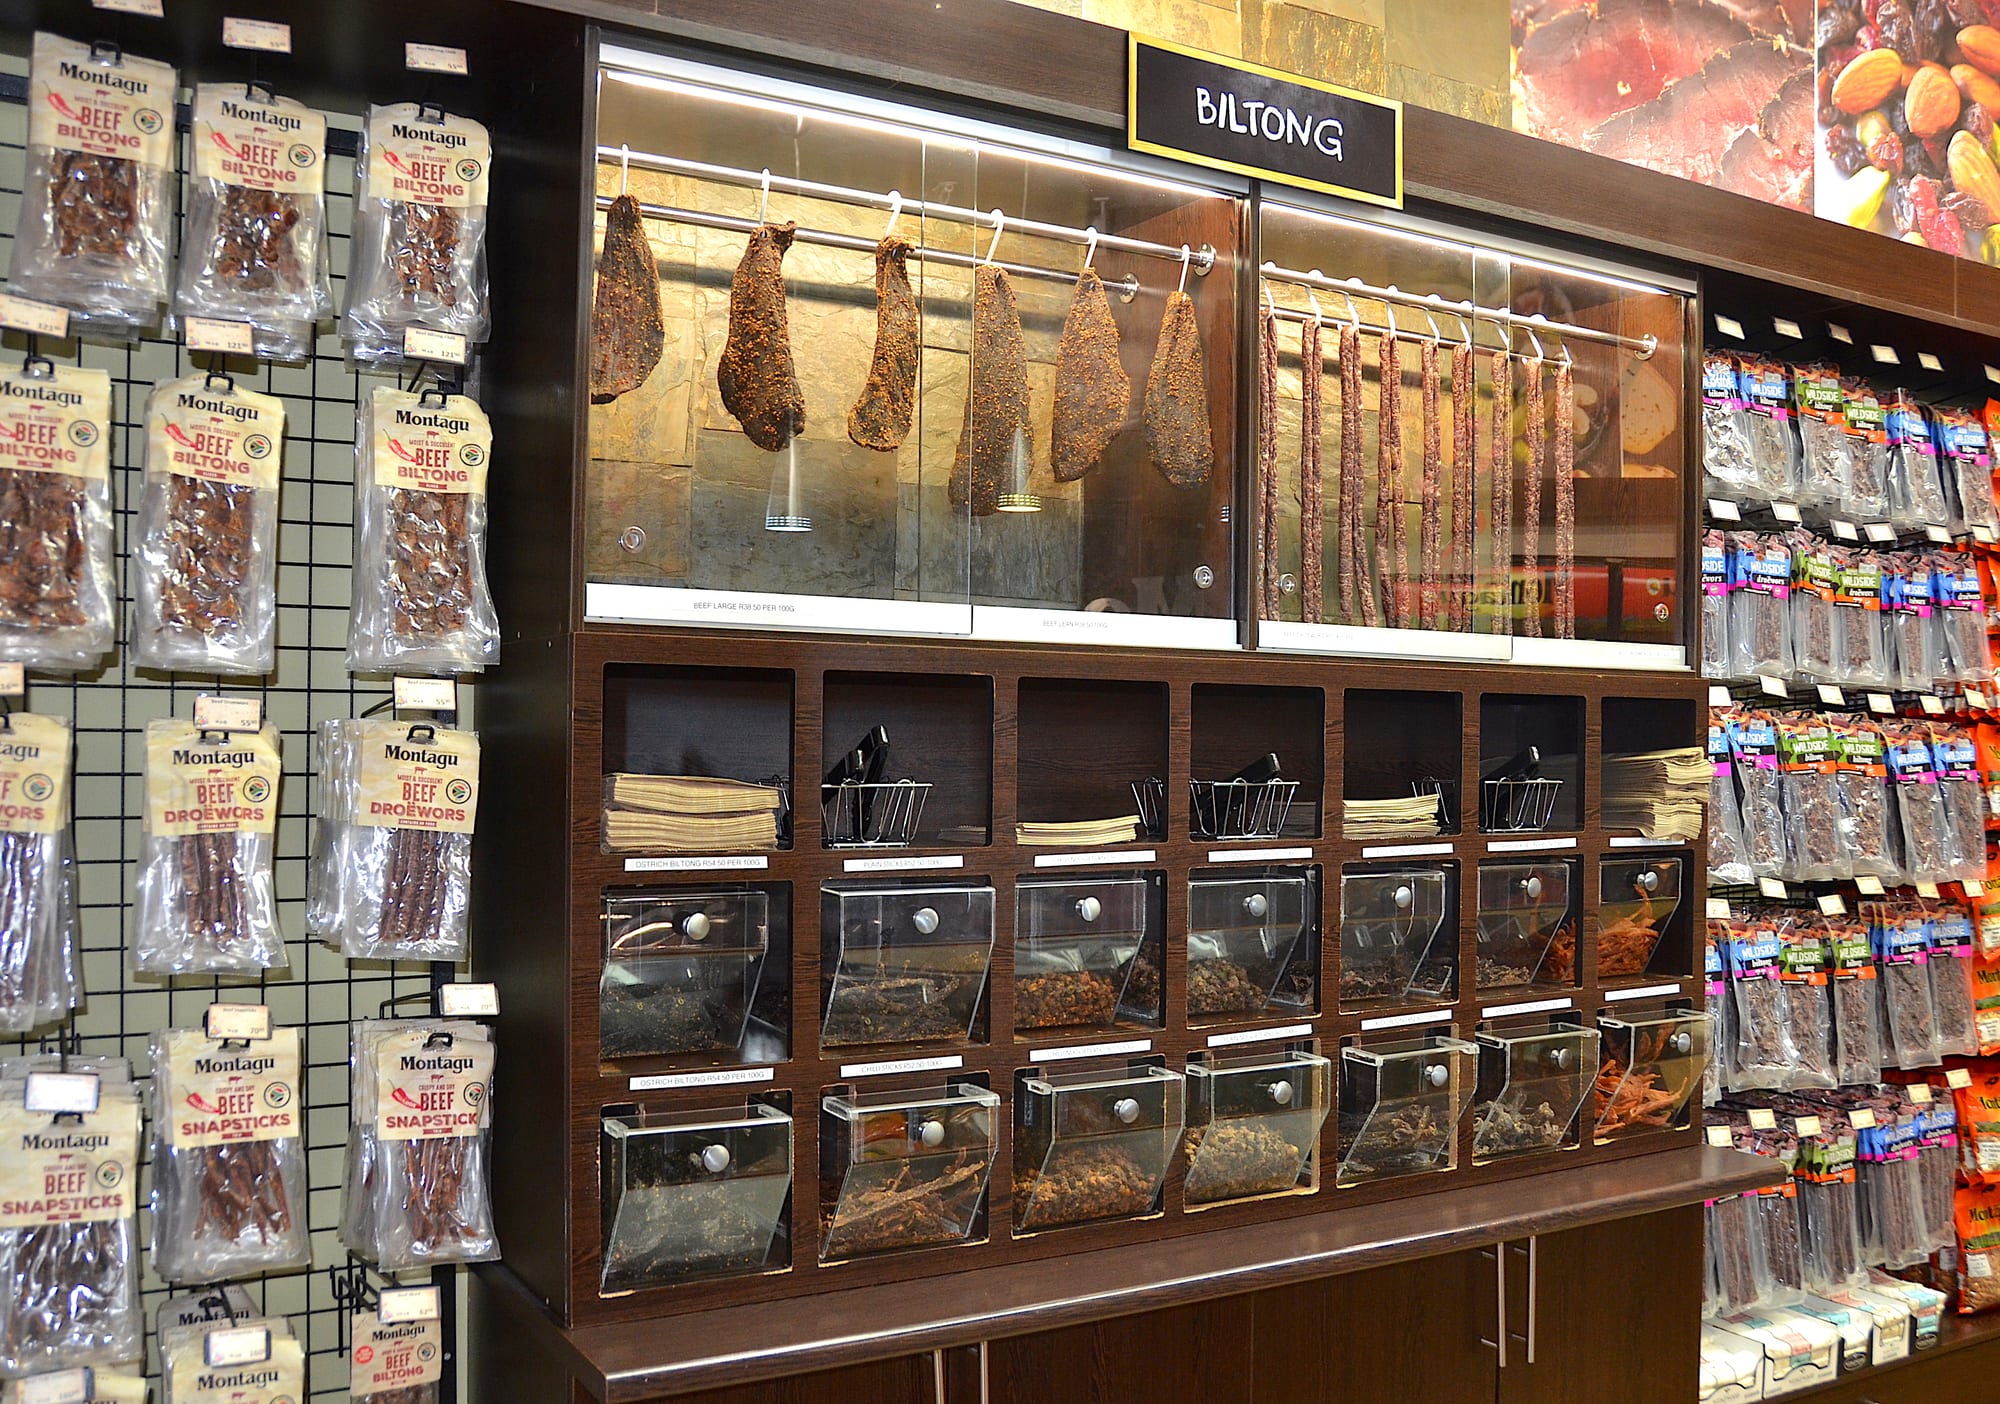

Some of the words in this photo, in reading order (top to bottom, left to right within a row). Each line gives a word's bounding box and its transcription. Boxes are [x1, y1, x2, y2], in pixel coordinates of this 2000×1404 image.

[59, 61, 149, 96] Montagu
[81, 106, 123, 131] BEEF
[221, 101, 301, 132] Montagu
[1196, 87, 1344, 162] BILTONG
[57, 124, 141, 148] BILTONG
[392, 124, 467, 149] Montagu
[241, 143, 278, 167] BEEF
[221, 160, 297, 183] BILTONG
[411, 161, 446, 182] BEEF
[393, 177, 464, 196] BILTONG
[177, 394, 259, 422] Montagu
[395, 410, 470, 434] Montagu
[15, 422, 57, 444] BEEF
[195, 432, 233, 457] BEEF
[173, 451, 250, 474] BILTONG
[415, 448, 450, 468] BEEF
[397, 466, 468, 482] BILTONG
[762, 604, 777, 612] PER
[173, 750, 255, 768] Montagu
[385, 745, 458, 769] Montagu
[197, 783, 235, 805] BEEF
[402, 782, 436, 803] BEEF
[164, 804, 265, 824] DROËWORS
[370, 801, 466, 822] DROËWORS
[669, 860, 702, 868] BILTONG
[726, 858, 742, 866] PER
[742, 858, 761, 866] 100G
[1741, 945, 1777, 959] WILDSIDE
[1786, 951, 1820, 963] WILDSIDE
[194, 1056, 274, 1074] Montagu
[400, 1056, 474, 1074] Montagu
[640, 1078, 673, 1087] OSTRICH
[674, 1076, 706, 1084] BILTONG
[731, 1072, 746, 1080] PER
[747, 1070, 765, 1079] 100G
[218, 1093, 254, 1116] BEEF
[420, 1092, 454, 1112] BEEF
[181, 1114, 291, 1136] SNAPSTICKS
[22, 1134, 109, 1152] Montagu
[45, 1172, 86, 1195] BEEF
[2, 1194, 123, 1216] SNAPSTICKS
[371, 1325, 425, 1342] Montagu
[386, 1353, 411, 1370] BEEF
[197, 1369, 279, 1392] Montagu
[372, 1366, 424, 1383] BILTONG
